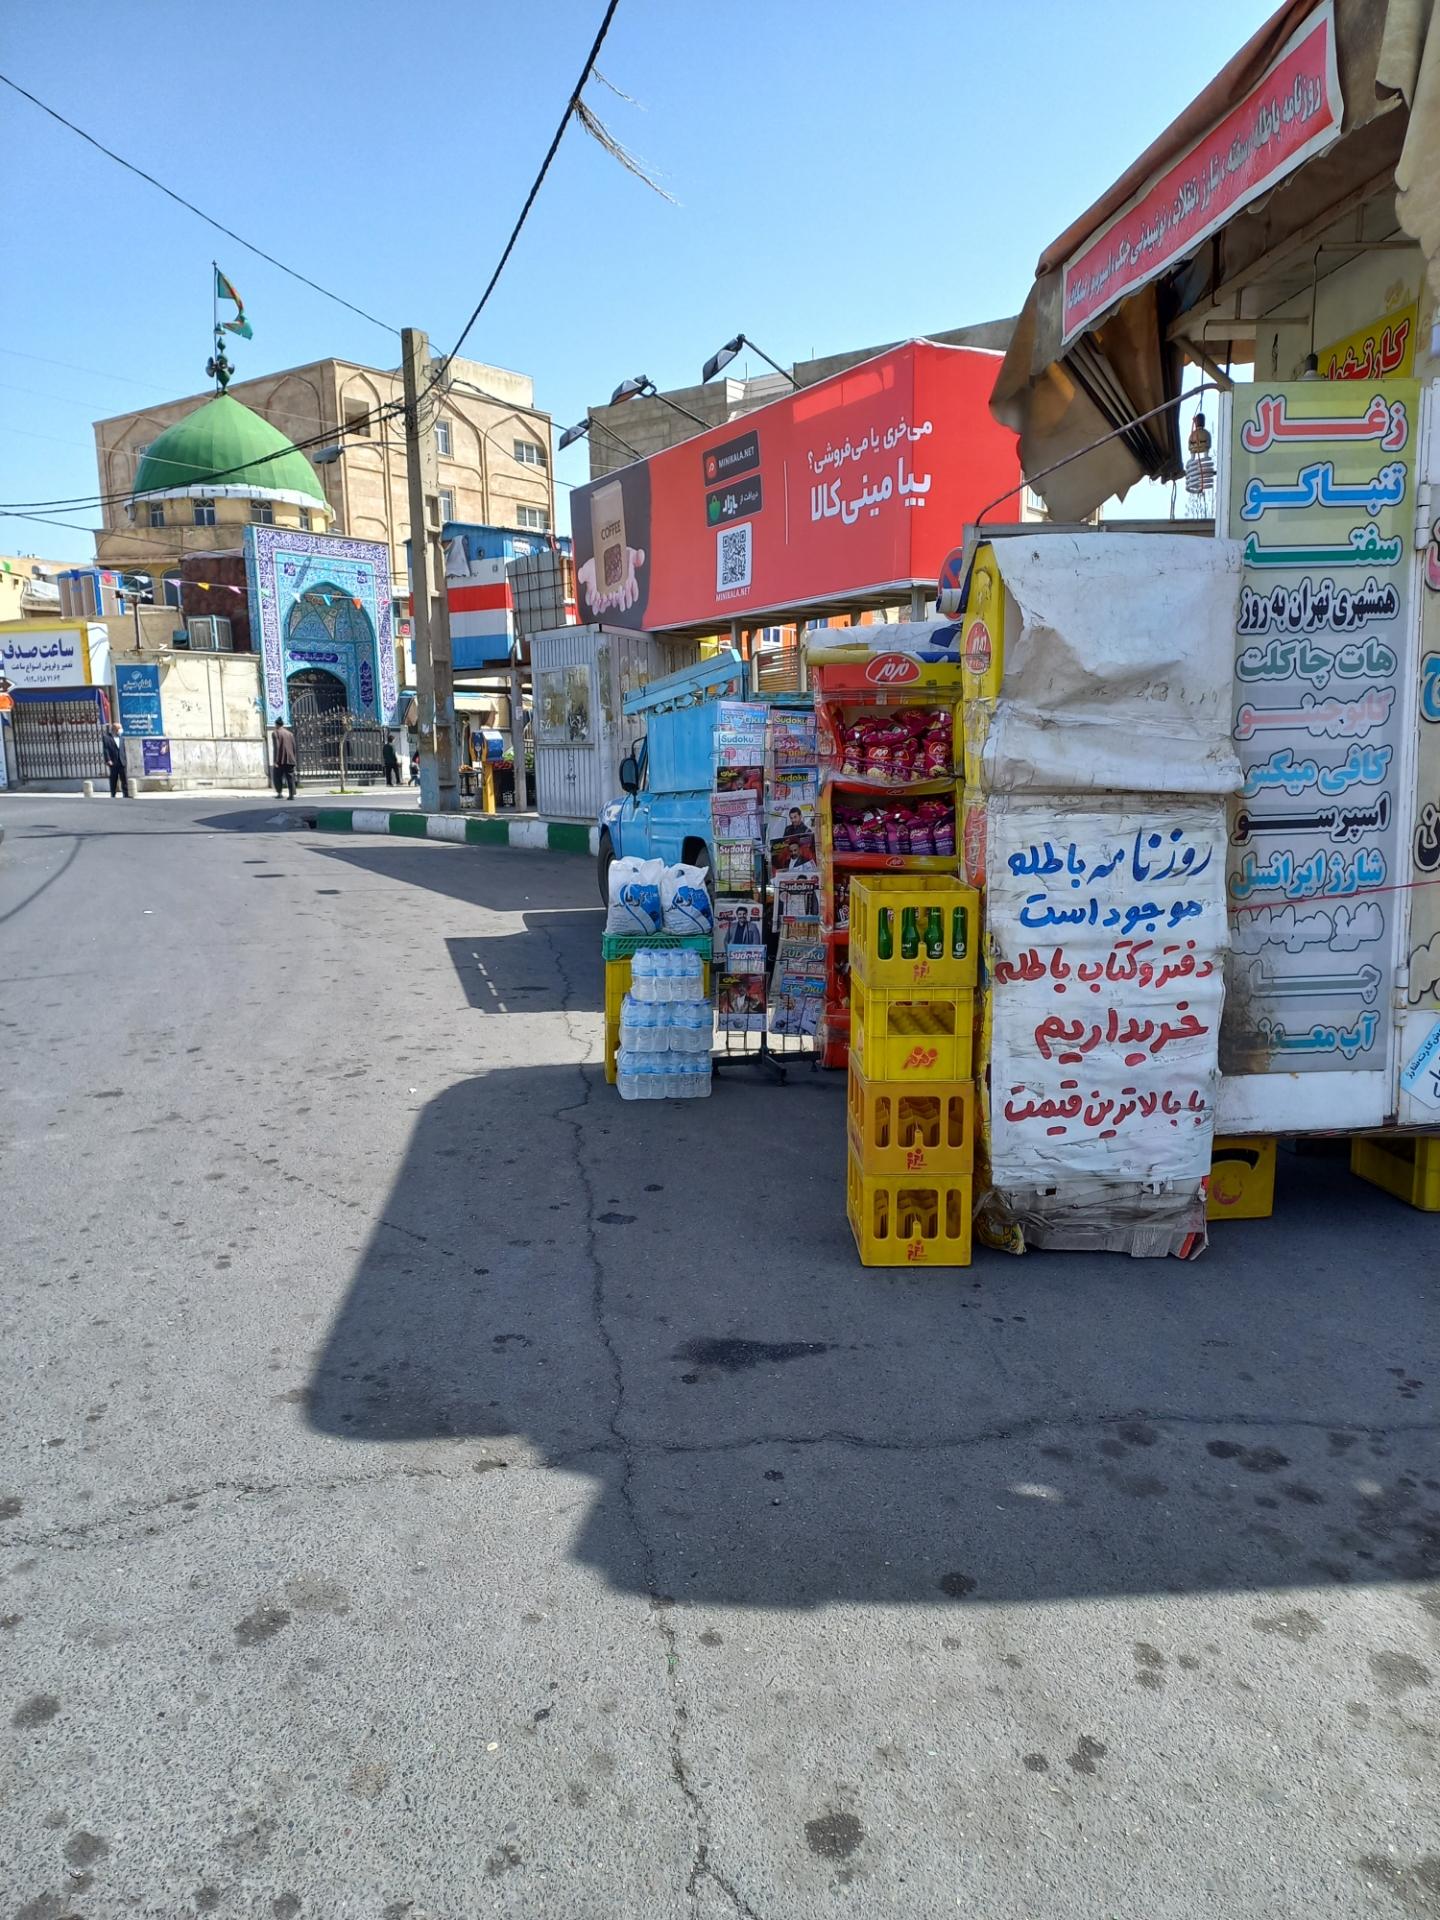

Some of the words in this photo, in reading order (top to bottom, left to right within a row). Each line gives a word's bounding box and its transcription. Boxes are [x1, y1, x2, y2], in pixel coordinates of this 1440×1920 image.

[1282, 73, 1321, 123] روزنامه
[870, 427, 880, 453] یا
[1242, 395, 1407, 452] زغال
[718, 446, 755, 469] MINIKALA.NET
[897, 456, 932, 507] بیا
[1241, 462, 1406, 519] تنباکو
[722, 494, 738, 516] بازار
[601, 520, 621, 541] COFFEE
[1244, 524, 1402, 567] سفته
[1239, 587, 1270, 633] روز
[1270, 586, 1288, 628] به
[1289, 577, 1333, 632] تهران
[1331, 577, 1399, 628] همشهری
[3, 639, 38, 659] صدف
[40, 637, 74, 658] ساعت
[1336, 637, 1396, 677] هات
[721, 733, 754, 744] Sudoku
[774, 715, 808, 726] Sudoku
[776, 774, 809, 783] Sudoku
[1236, 749, 1318, 797] میکس
[1319, 744, 1392, 795] کافی
[1232, 792, 1391, 845] اسپرسو
[1008, 842, 1086, 888] باطله
[1086, 826, 1214, 885] روزنامه
[1230, 849, 1326, 898] ایرانسل
[1325, 849, 1387, 896] شارژ
[1019, 893, 1099, 928] است
[1103, 898, 1203, 935] موجود
[994, 947, 1072, 993] باطله
[1077, 939, 1154, 994] کتاب
[1155, 939, 1214, 988] دفتر
[1035, 1001, 1210, 1066] خریداریم
[1339, 1011, 1380, 1060] آب
[1003, 1080, 1083, 1136] قیمت
[1083, 1087, 1182, 1138] بالاترین
[1188, 1090, 1206, 1124] با
